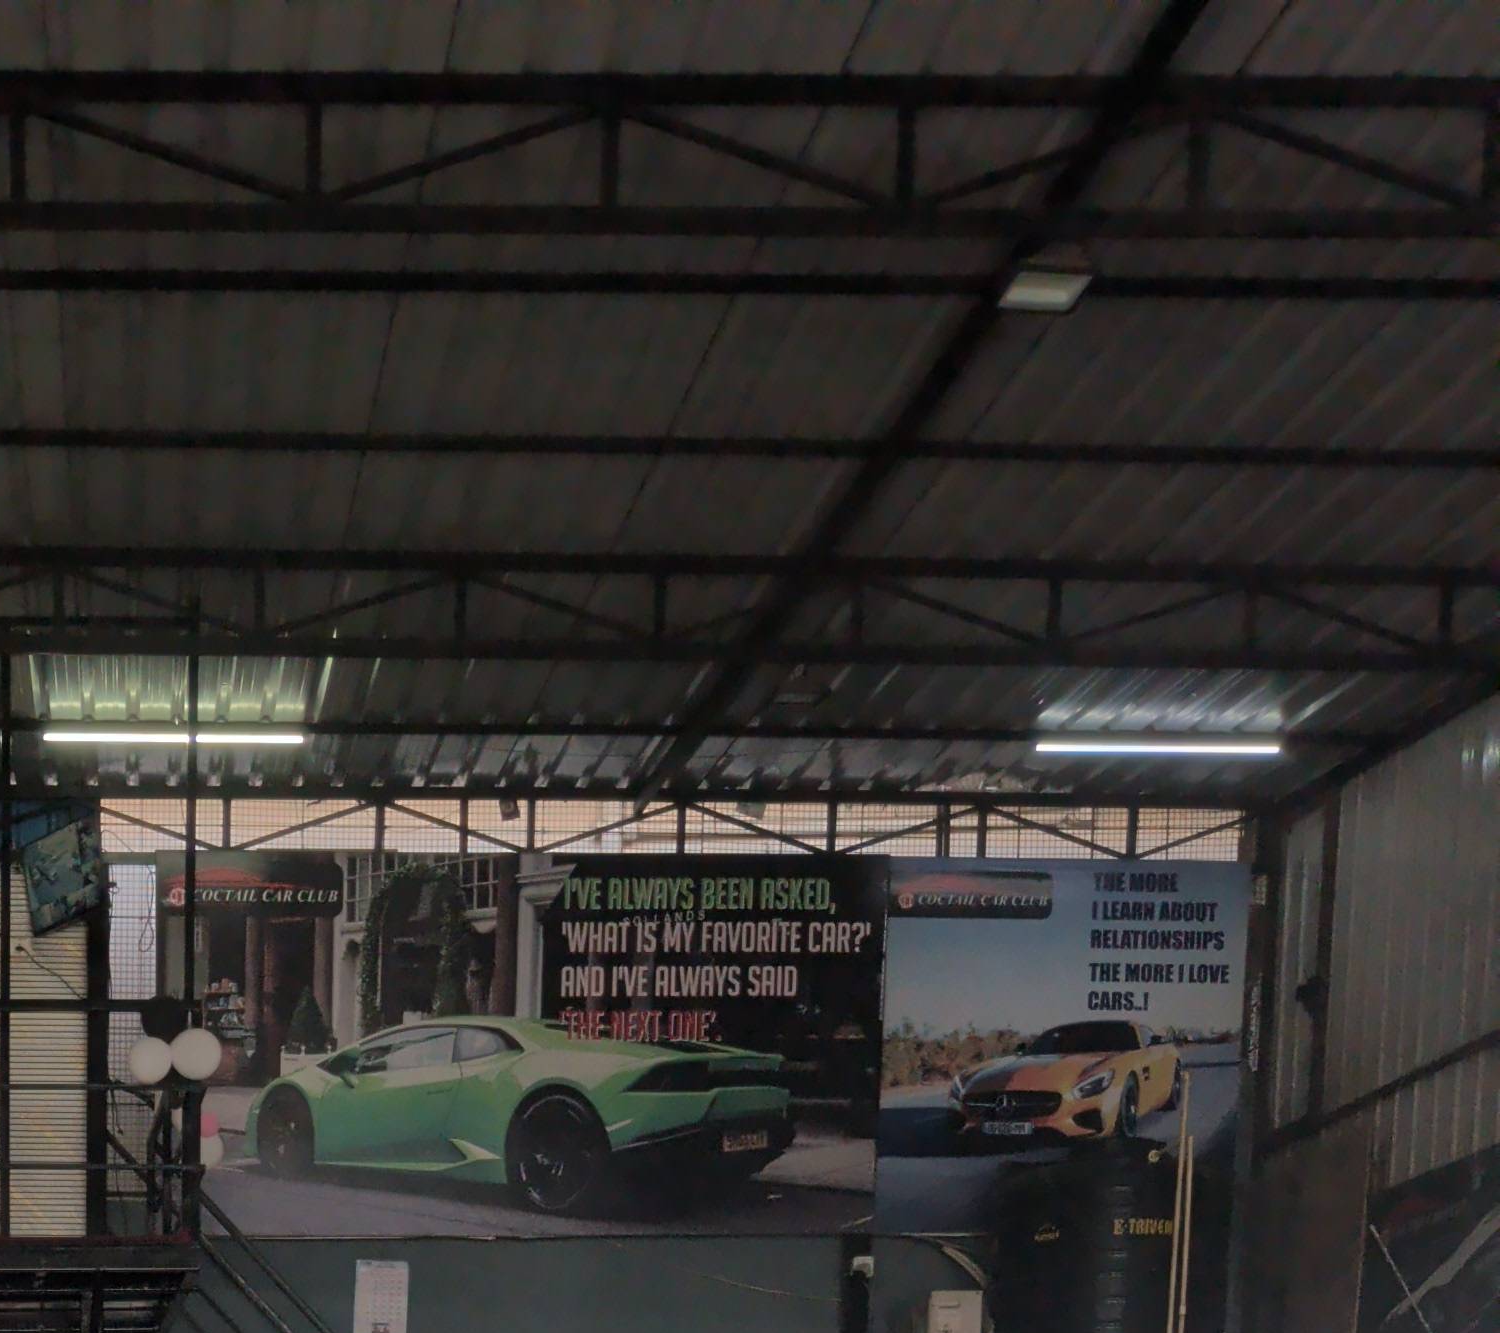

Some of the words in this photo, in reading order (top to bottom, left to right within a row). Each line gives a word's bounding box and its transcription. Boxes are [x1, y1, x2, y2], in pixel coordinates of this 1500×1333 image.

[1093, 872, 1125, 893] THE
[1129, 872, 1179, 893] MORE
[262, 888, 293, 903] CAR
[297, 888, 339, 903] CLUB
[563, 878, 601, 910] I'VE
[607, 878, 694, 910] ALWAYS
[701, 878, 753, 910] BEEN
[760, 878, 836, 915] ASKED,
[980, 894, 1008, 907] CAR
[1011, 894, 1048, 907] CLUB
[1091, 901, 1098, 921] I
[1102, 901, 1156, 921] LEARN
[1160, 902, 1218, 923] ABOUT
[636, 921, 657, 953] IS
[663, 922, 695, 953] MY
[701, 920, 801, 953] FAVORITE
[1090, 929, 1225, 951] RELATIONSHIPS
[560, 965, 604, 997] AND
[612, 965, 649, 997] I'VE
[655, 965, 741, 997] ALWAYS
[748, 965, 798, 997] SAID
[1089, 962, 1121, 983] THE
[1125, 963, 1174, 983] MORE
[1178, 964, 1184, 983] I
[1188, 964, 1230, 984] LOVE
[611, 1009, 663, 1042] NEXT
